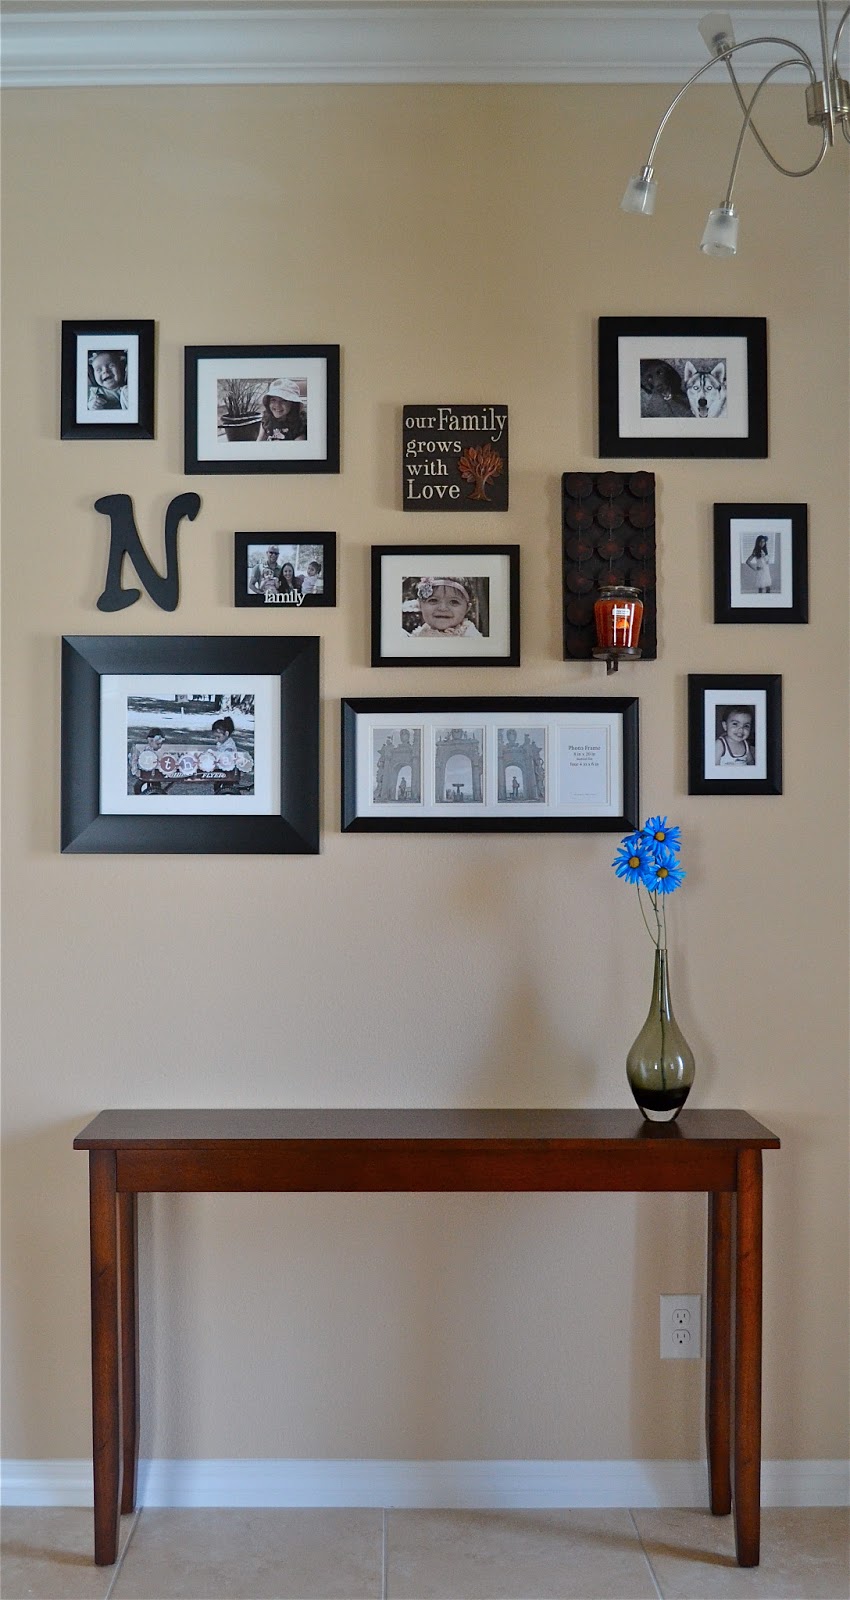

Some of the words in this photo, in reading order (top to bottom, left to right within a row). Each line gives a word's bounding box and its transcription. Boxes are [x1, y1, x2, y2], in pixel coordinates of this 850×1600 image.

[405, 416, 436, 429] our
[437, 408, 507, 442] Family
[406, 439, 461, 457] grows
[406, 459, 448, 476] with
[407, 479, 460, 499] Love
[94, 492, 200, 612] N
[264, 588, 306, 607] family
